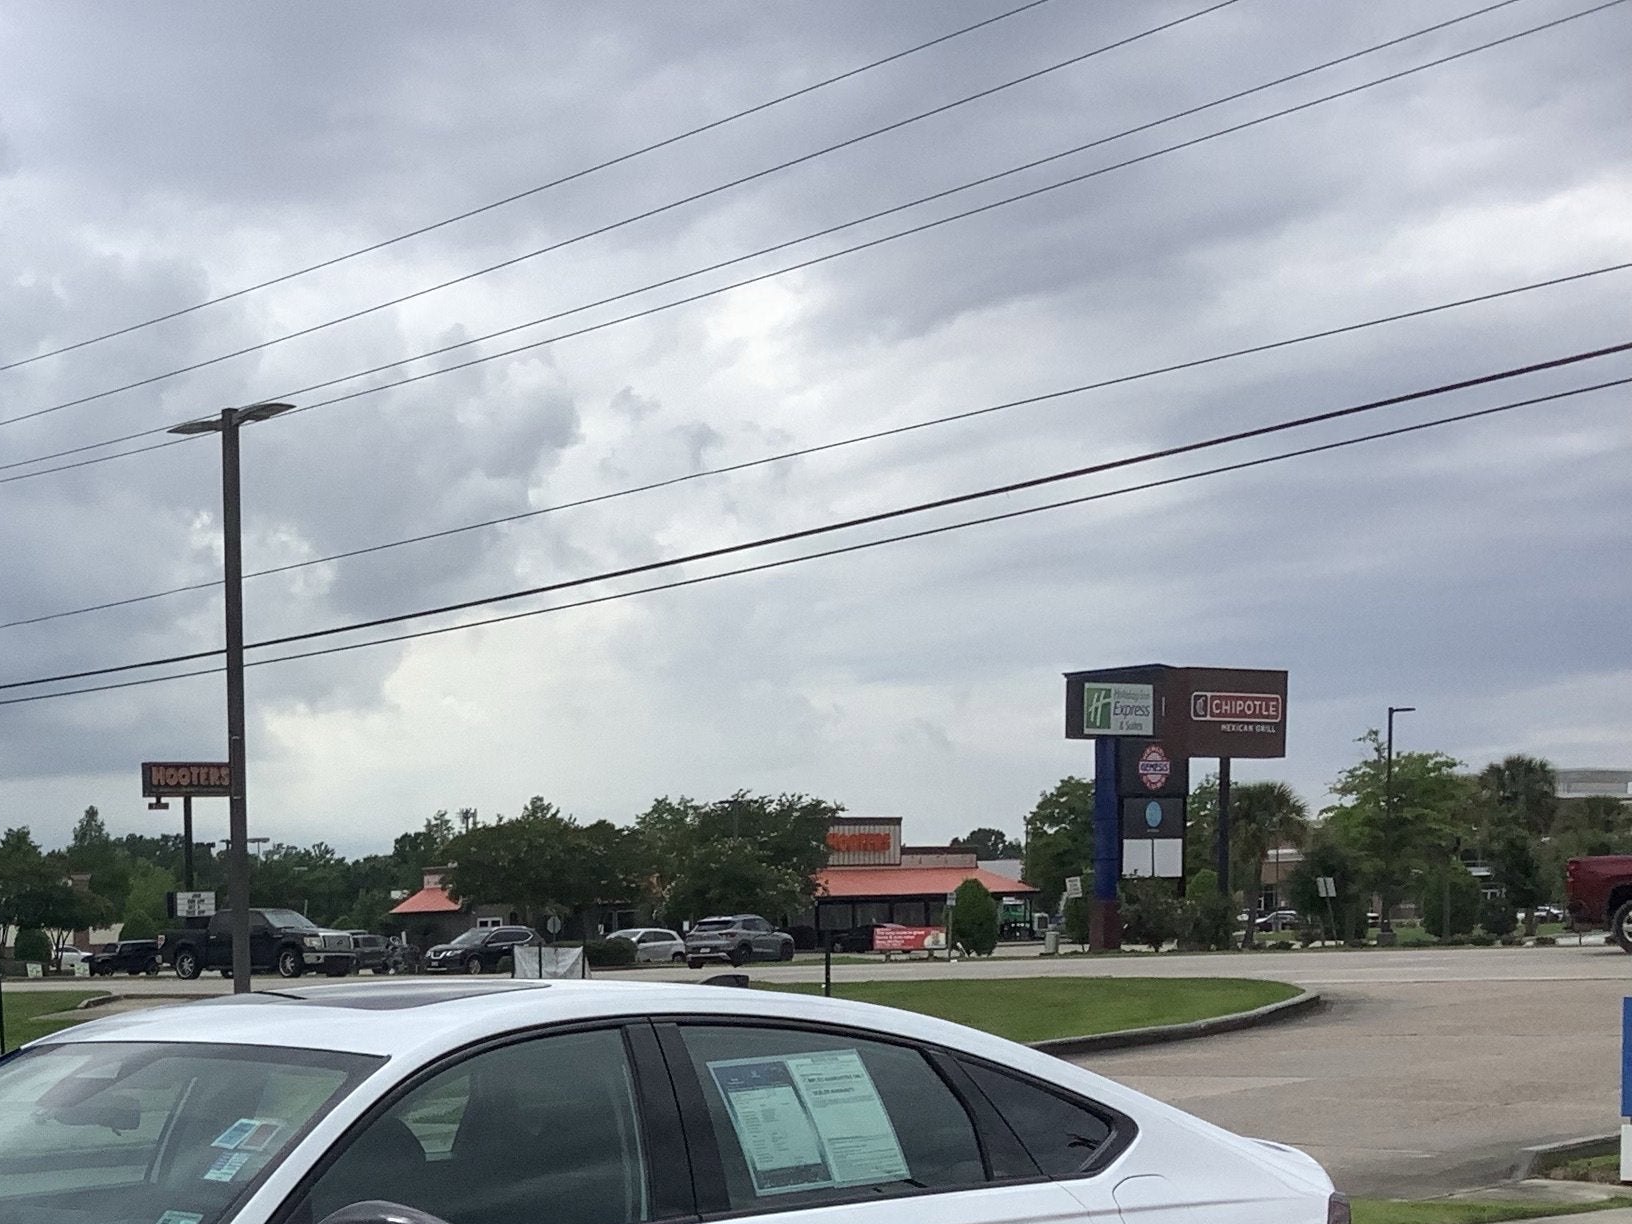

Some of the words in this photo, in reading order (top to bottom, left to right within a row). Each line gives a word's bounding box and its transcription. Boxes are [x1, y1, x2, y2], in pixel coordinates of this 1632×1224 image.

[1113, 700, 1151, 719] Express
[1212, 699, 1278, 716] CHIPOTLE
[1220, 723, 1254, 732] MEXICAN
[1255, 724, 1276, 733] GRILL
[151, 766, 230, 786] HOOTERS
